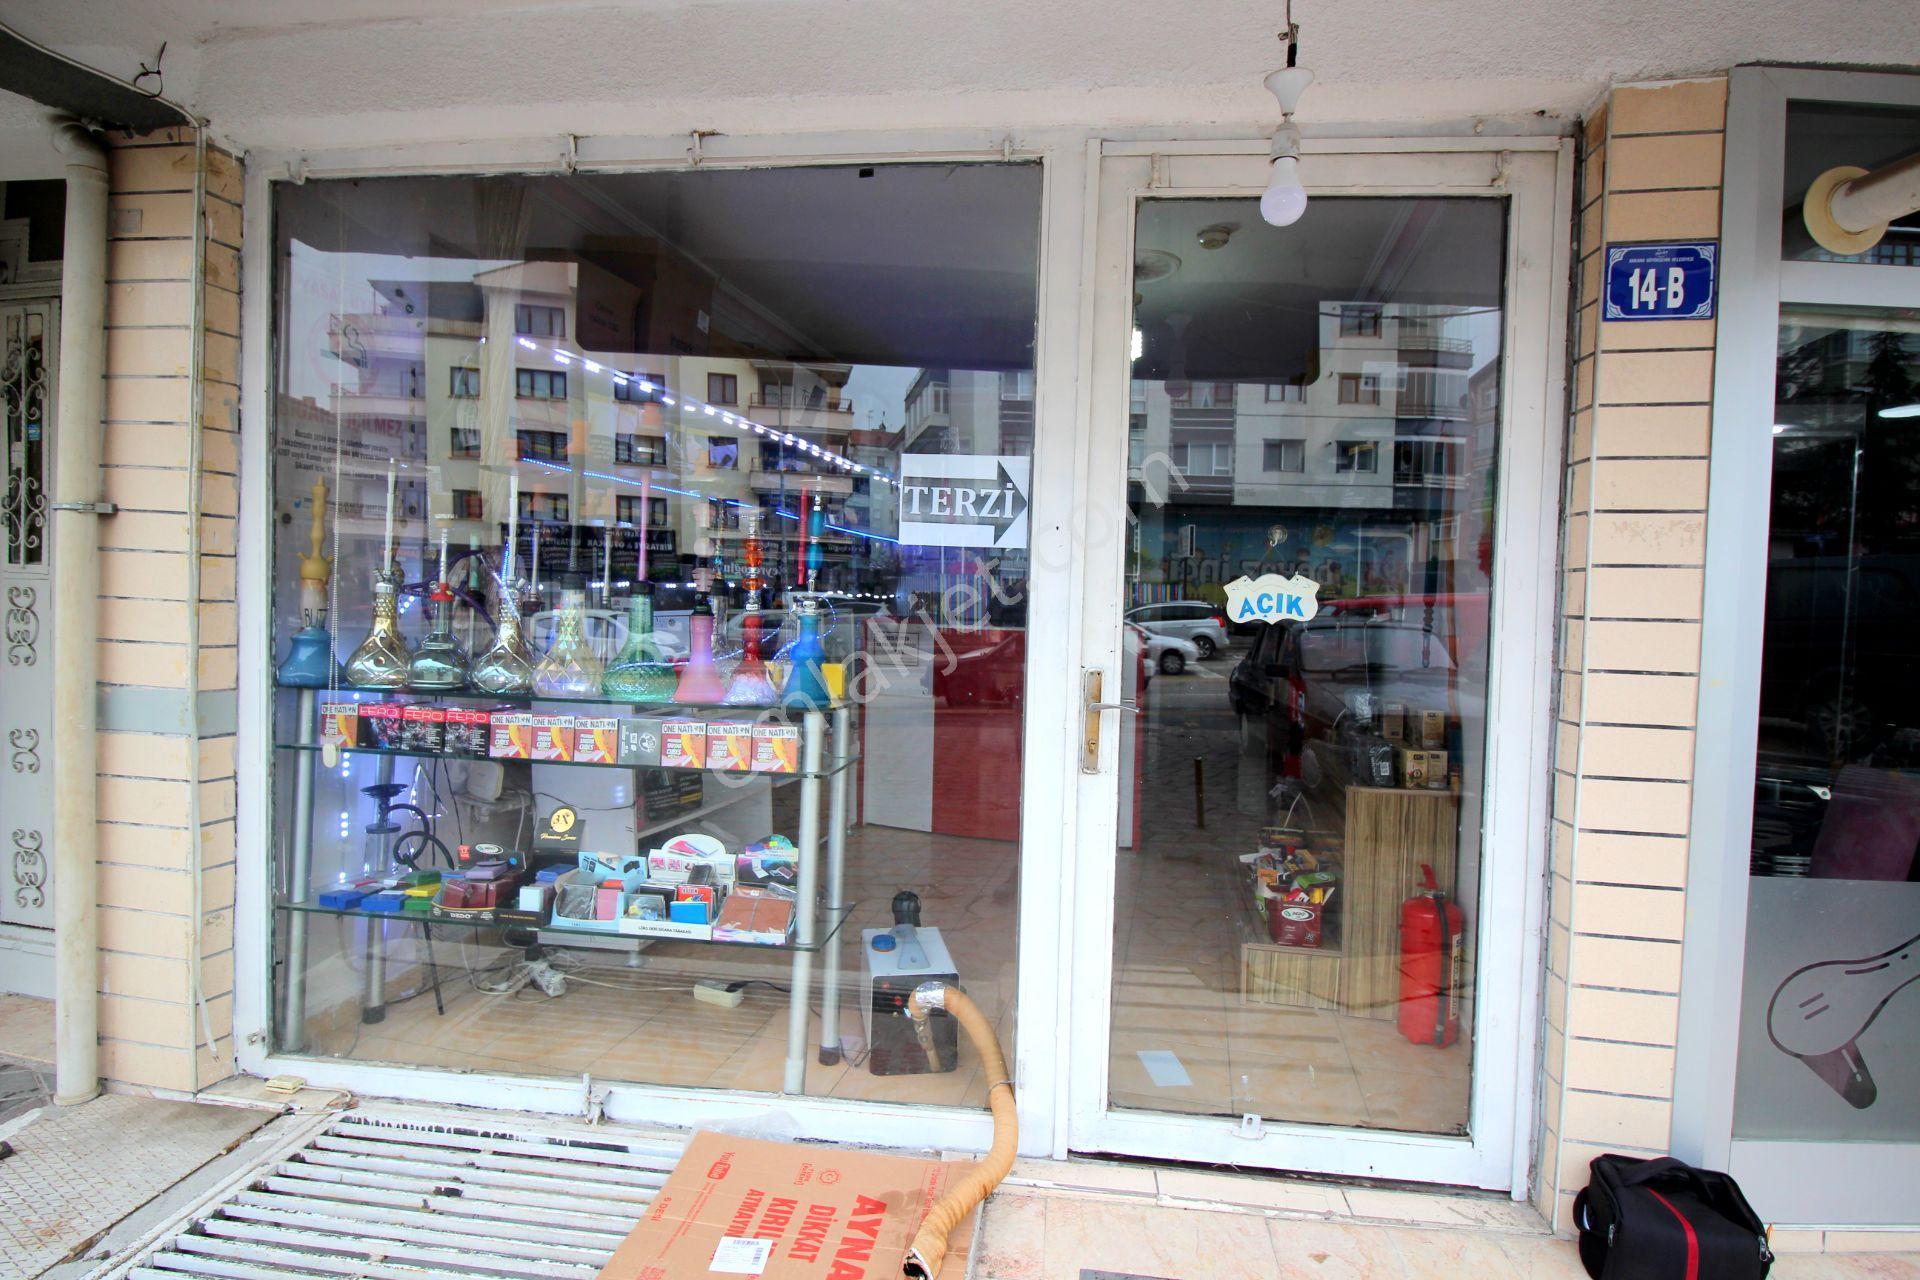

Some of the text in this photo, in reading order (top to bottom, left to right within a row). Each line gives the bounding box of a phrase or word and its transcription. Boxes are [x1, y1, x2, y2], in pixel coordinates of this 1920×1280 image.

[1629, 267, 1684, 310] 14-B
[903, 483, 1014, 520] TERZİ
[1238, 593, 1305, 619] AÇIK
[404, 710, 443, 720] FERO
[447, 712, 487, 722] FERO
[492, 716, 505, 724] ONE
[576, 720, 589, 728] ONE
[787, 1204, 838, 1264] DİKKAT
